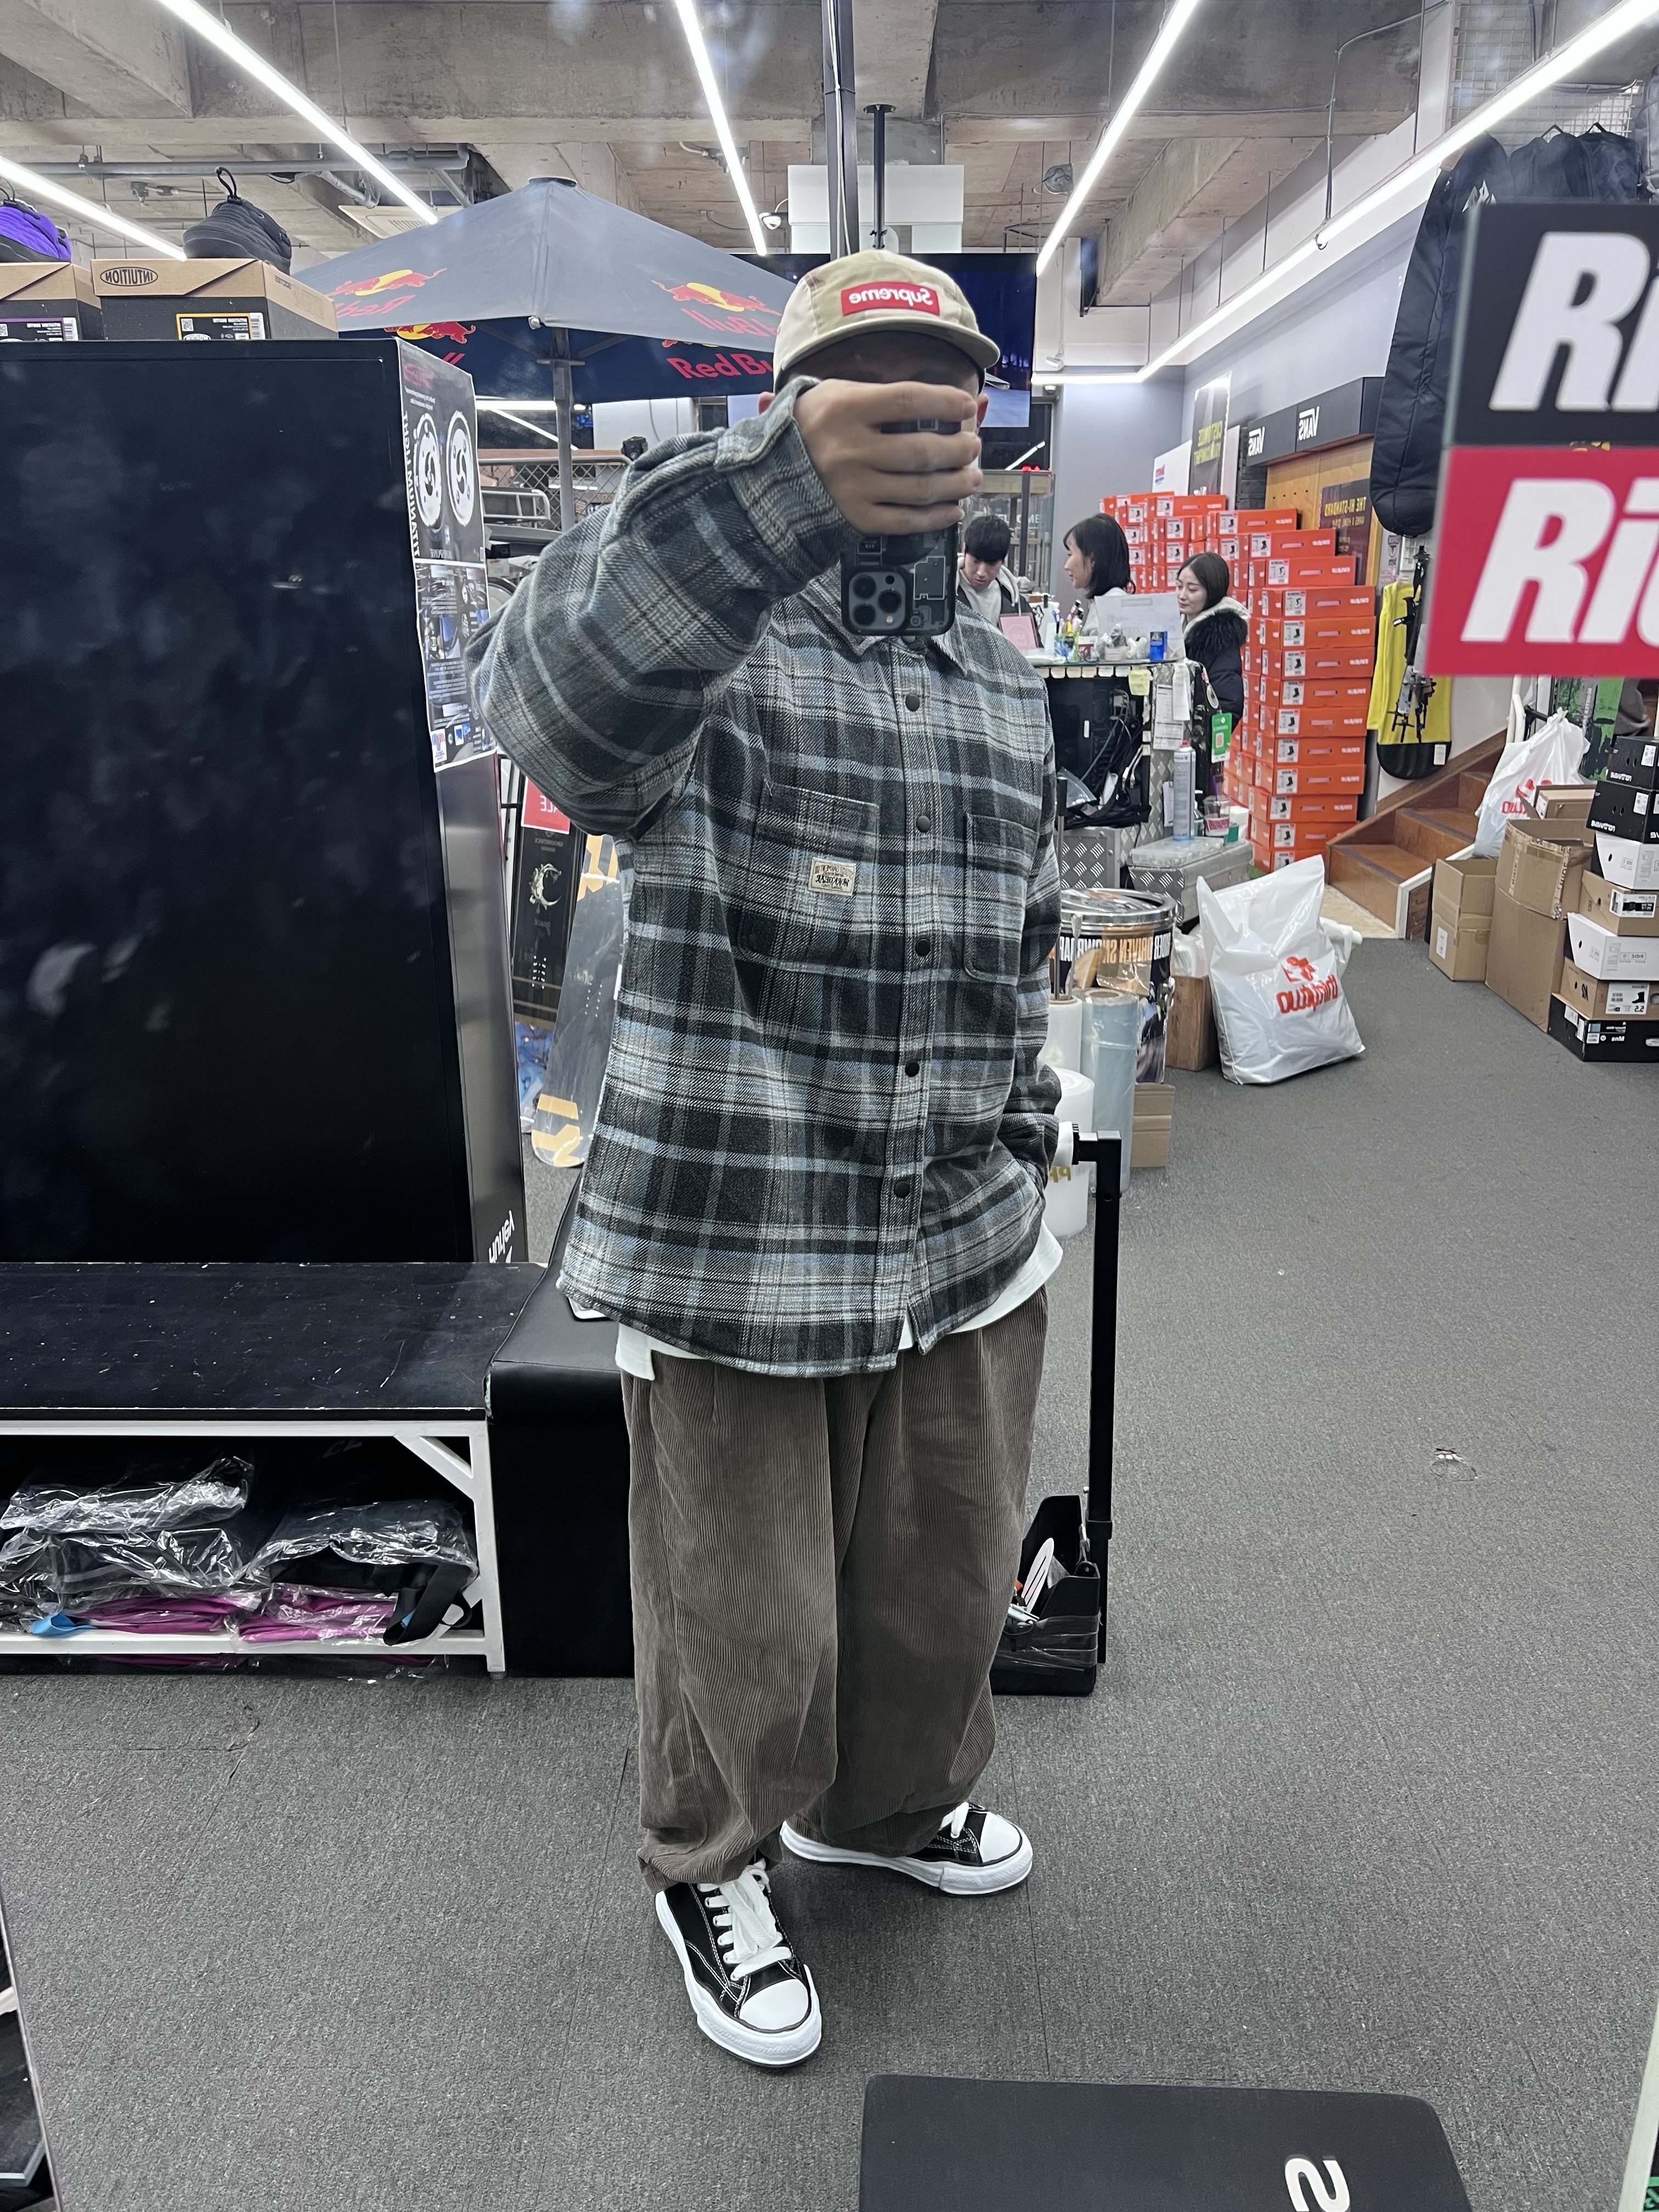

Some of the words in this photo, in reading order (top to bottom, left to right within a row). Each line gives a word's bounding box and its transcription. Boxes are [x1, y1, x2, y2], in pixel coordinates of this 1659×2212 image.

[667, 354, 741, 379] Red
[730, 353, 774, 375] Bu
[1461, 478, 1659, 646] Ri
